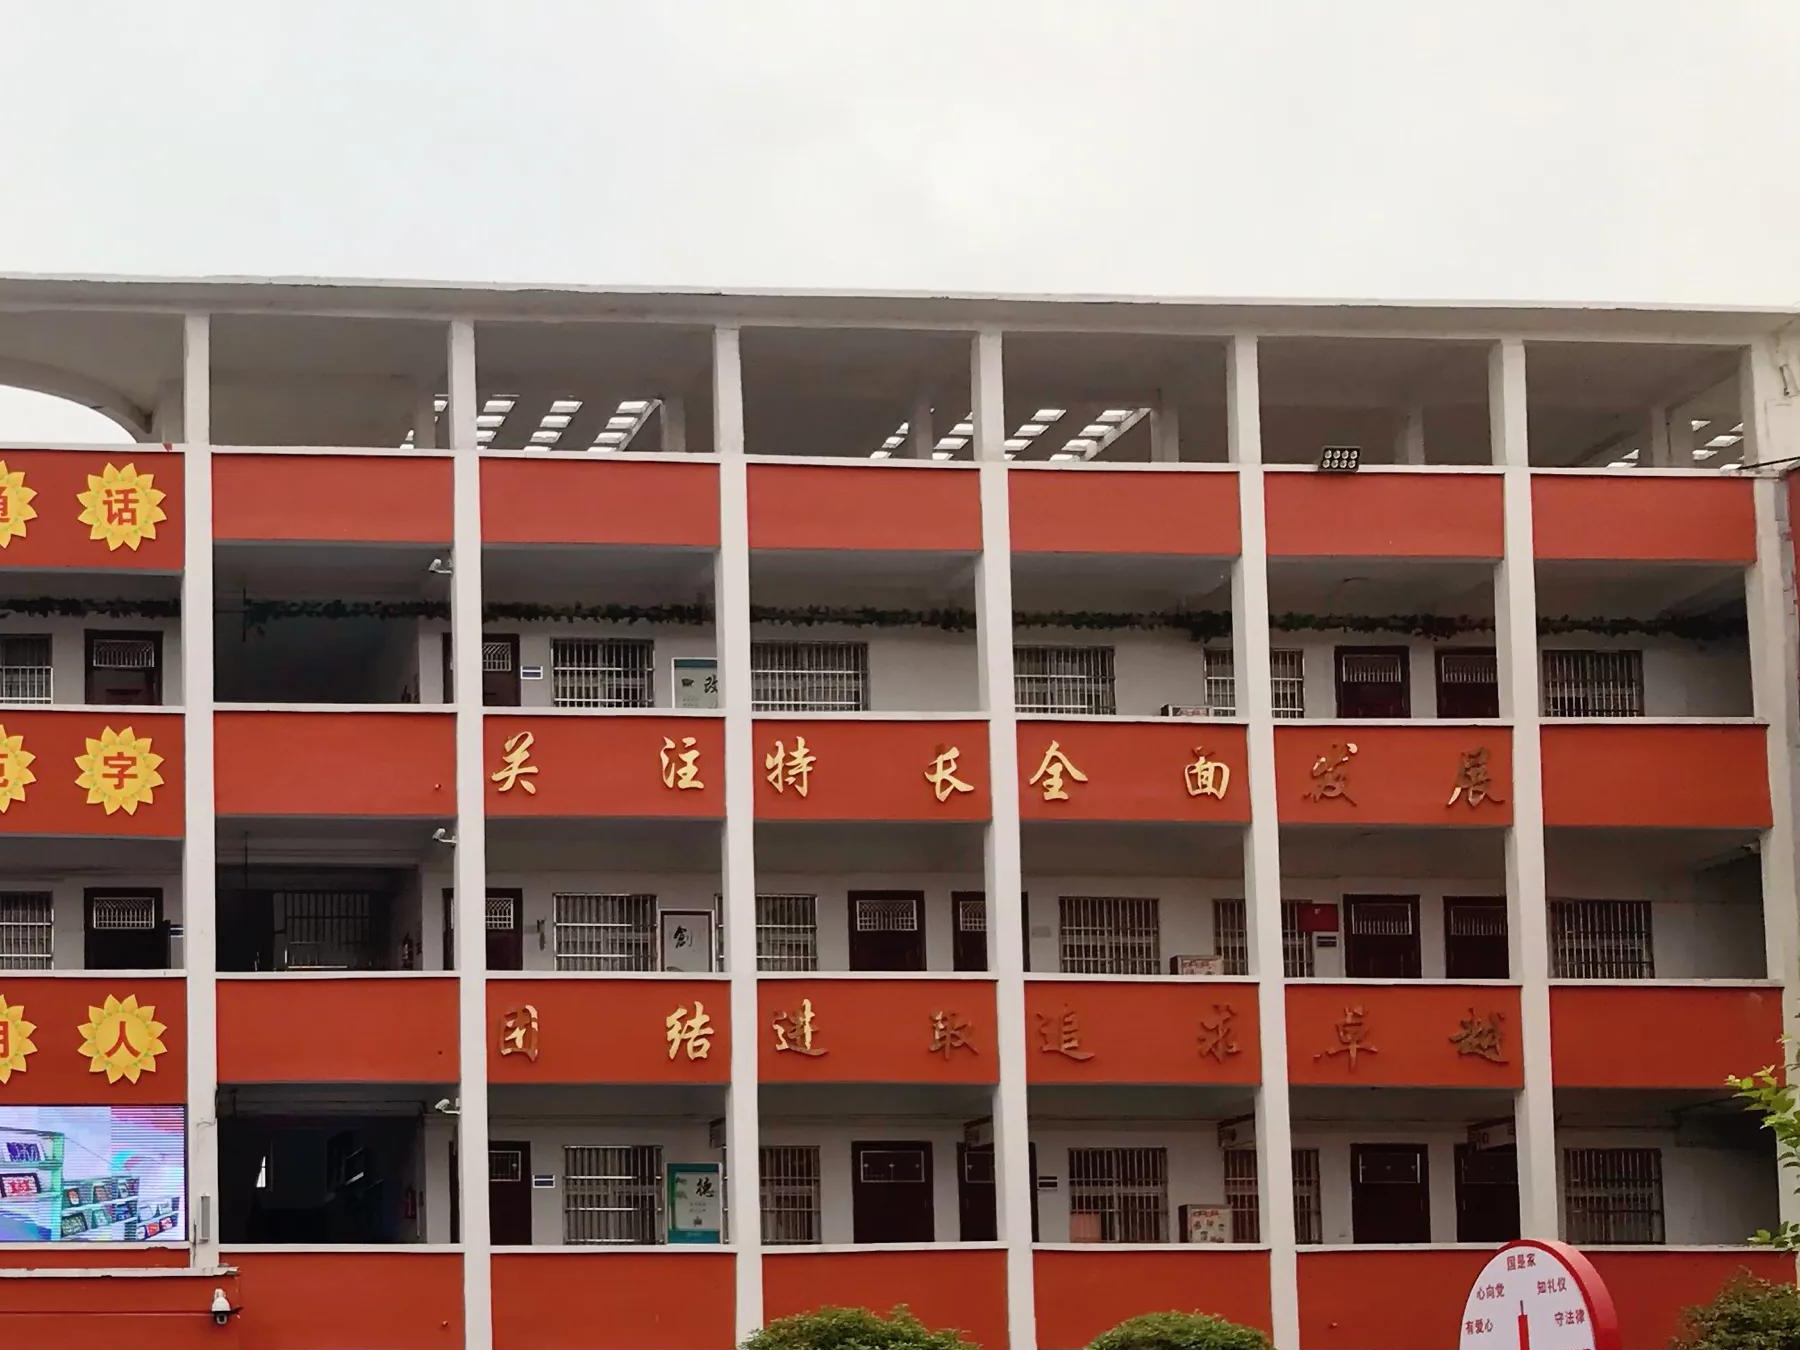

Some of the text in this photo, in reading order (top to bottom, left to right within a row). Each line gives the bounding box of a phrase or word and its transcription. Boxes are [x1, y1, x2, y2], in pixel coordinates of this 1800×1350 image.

[1476, 1282, 1505, 1300] 心向党
[1536, 1277, 1568, 1295] 知礼仪
[1465, 1318, 1494, 1335] 有爱心
[1554, 1309, 1586, 1327] 守法律
